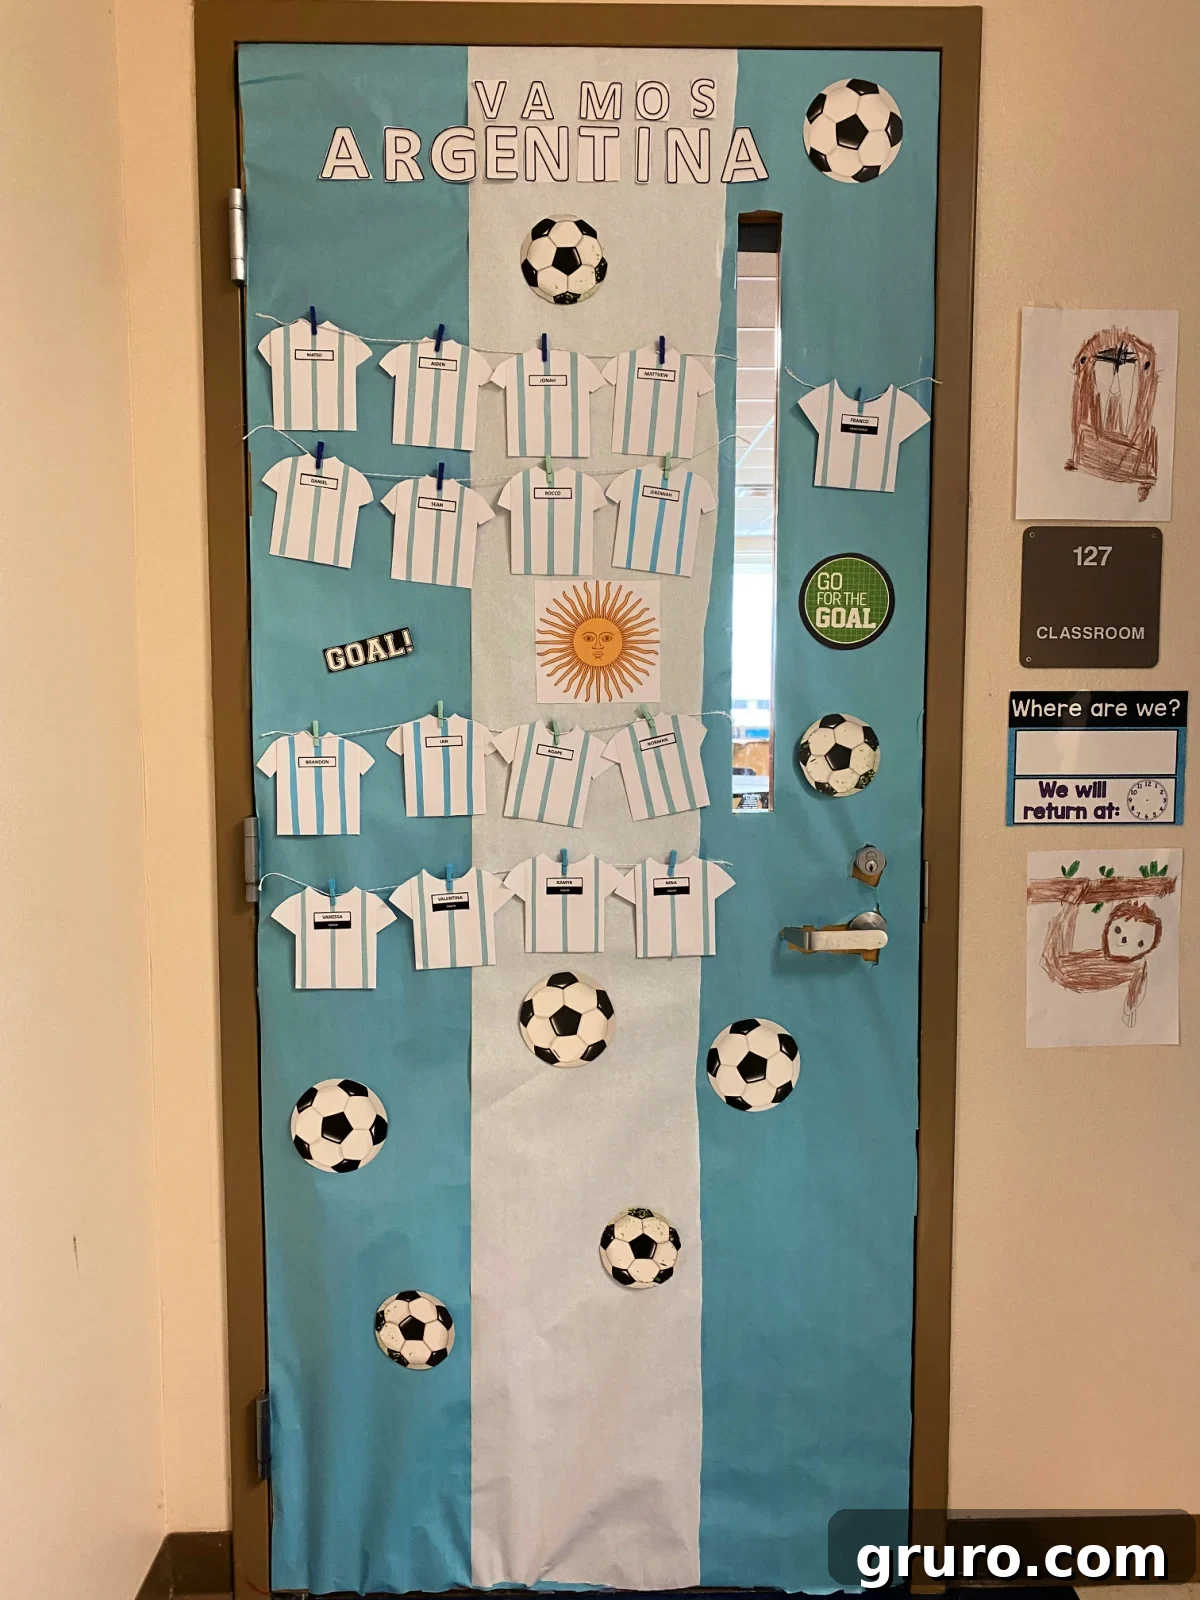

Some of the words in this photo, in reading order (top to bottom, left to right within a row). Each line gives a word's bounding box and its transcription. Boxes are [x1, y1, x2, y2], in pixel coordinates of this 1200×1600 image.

[474, 78, 716, 122] VAMOS
[319, 125, 770, 183] ARGENTINA
[310, 478, 328, 486] DANIEL
[649, 489, 673, 497] JEREMIAH
[1073, 545, 1112, 566] 127
[817, 572, 843, 590] GO
[817, 592, 842, 606] FOR
[844, 592, 867, 606] THE
[815, 607, 876, 629] GOAL
[1036, 626, 1145, 640] CLASSROOM
[325, 629, 414, 672] GOAL!
[1012, 699, 1082, 717] Where
[1090, 701, 1127, 717] are
[1136, 699, 1181, 717] we?
[647, 737, 669, 746] NORMAN
[1038, 781, 1068, 798] We
[1075, 781, 1107, 798] will
[1023, 803, 1087, 820] return
[1093, 802, 1120, 820] at:
